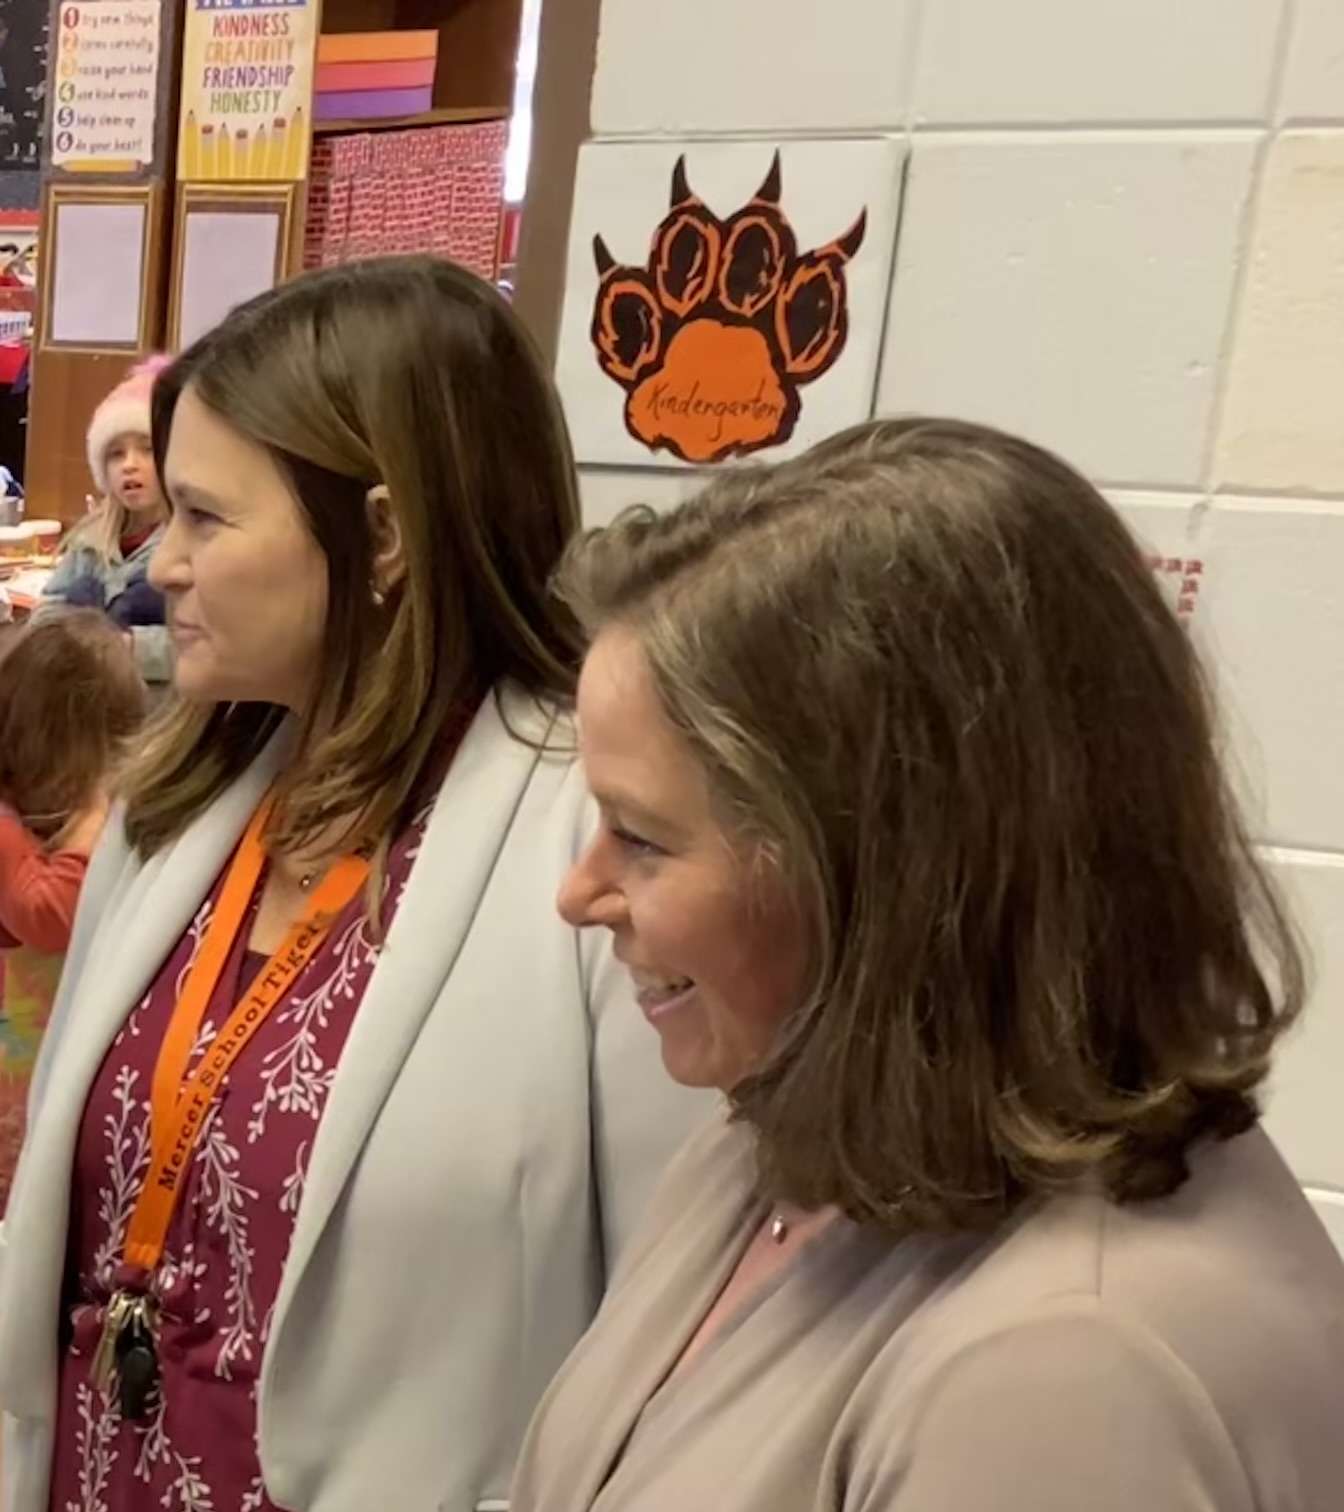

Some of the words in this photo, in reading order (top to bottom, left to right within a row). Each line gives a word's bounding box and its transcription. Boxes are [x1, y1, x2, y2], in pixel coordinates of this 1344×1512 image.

[212, 12, 289, 37] KINDNESS
[205, 38, 295, 64] CREATIVITY
[202, 64, 295, 89] FRIENDSHIP
[210, 89, 282, 115] HONESTY
[647, 378, 779, 442] Kindergarten
[158, 1092, 205, 1193] Mercer
[199, 996, 269, 1088] School
